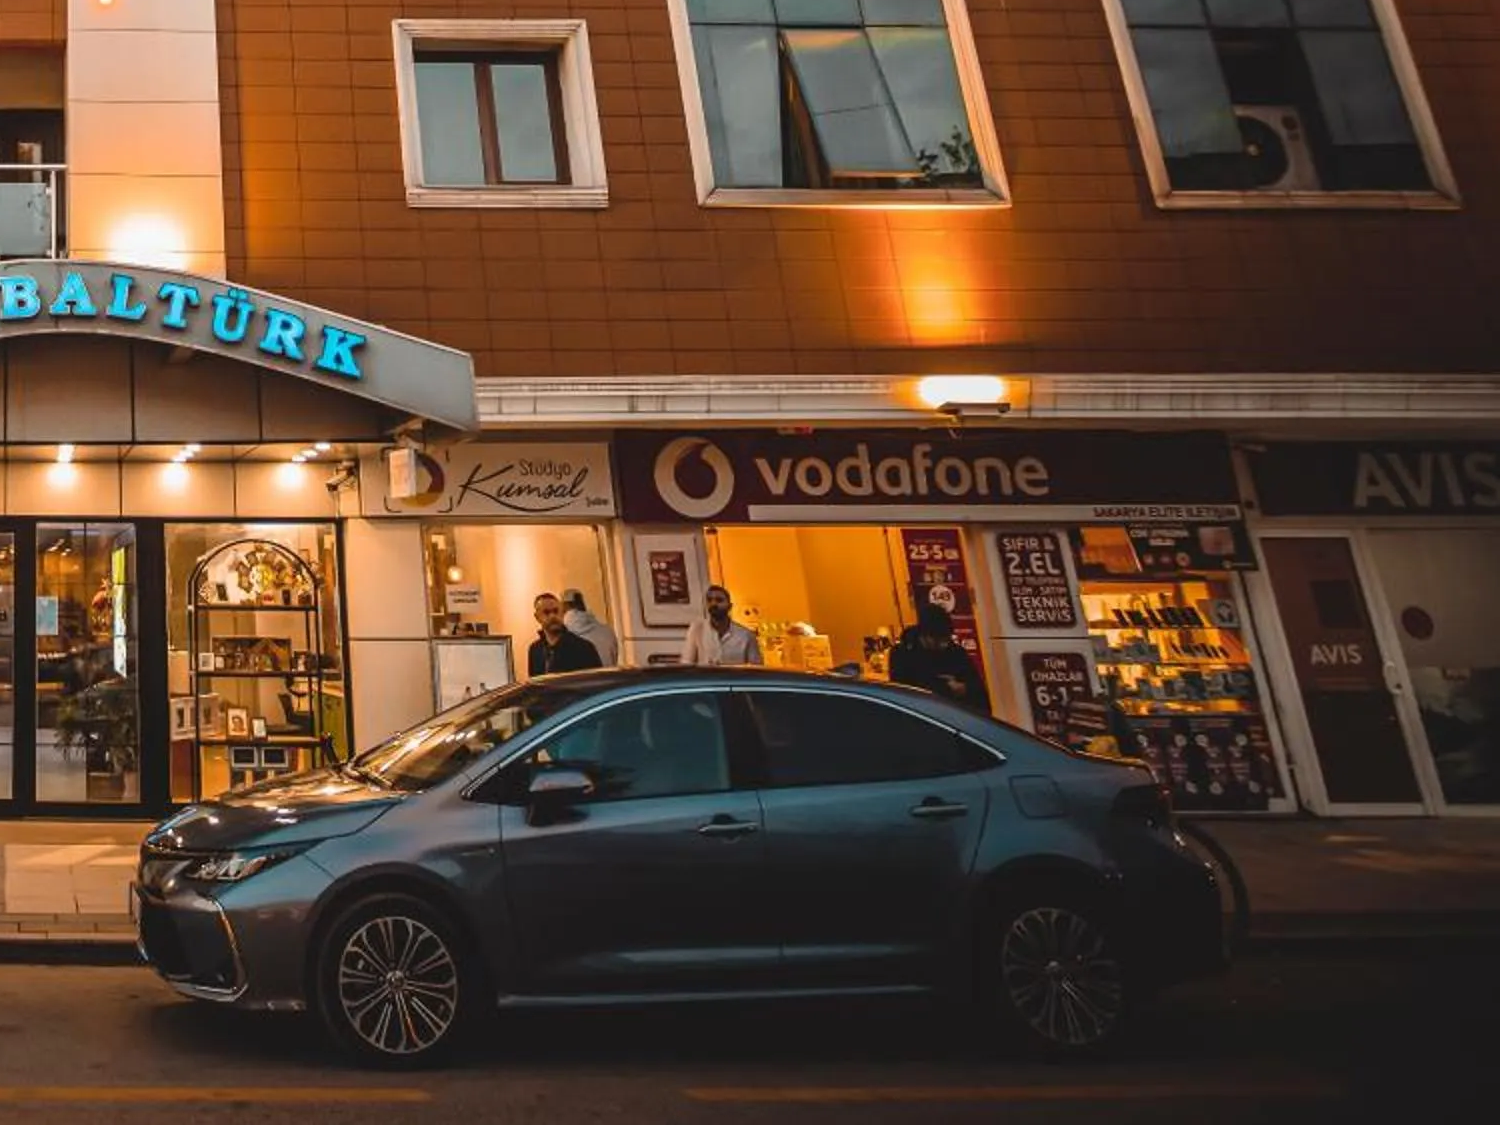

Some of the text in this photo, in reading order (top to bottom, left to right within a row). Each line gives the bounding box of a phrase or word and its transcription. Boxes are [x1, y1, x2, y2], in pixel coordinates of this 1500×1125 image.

[456, 462, 589, 513] Kumsal
[755, 442, 1050, 497] vodafone
[1354, 452, 1500, 508] AVIS
[1005, 552, 1062, 575] 2.EL
[1310, 643, 1362, 665] AVIS
